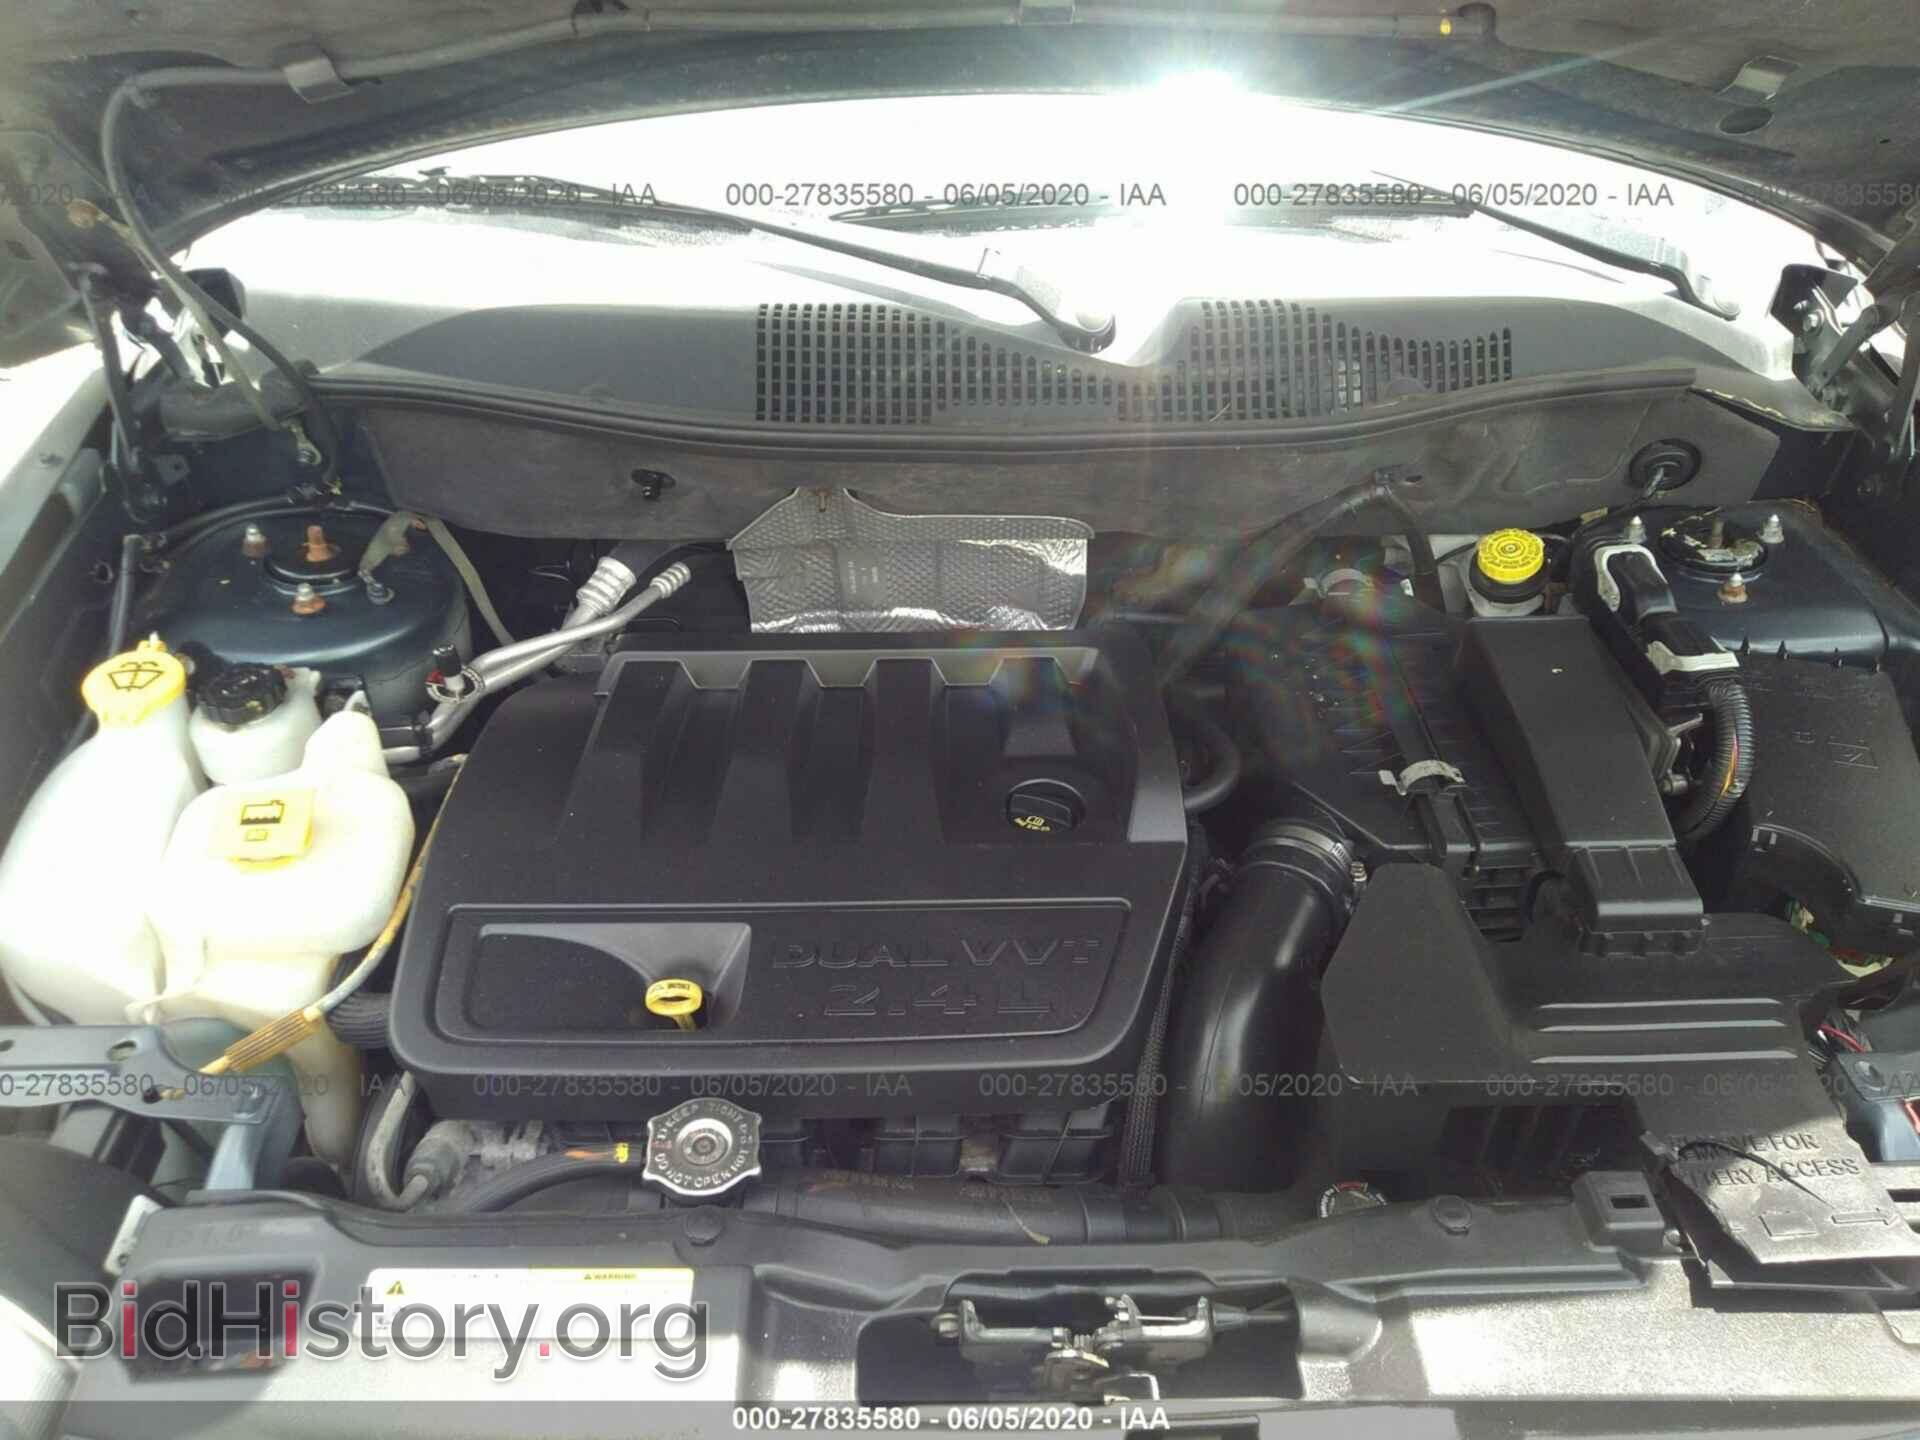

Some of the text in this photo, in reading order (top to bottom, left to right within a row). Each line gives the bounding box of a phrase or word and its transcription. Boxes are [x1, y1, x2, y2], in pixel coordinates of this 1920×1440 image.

[773, 937, 1100, 968] DUAL VVT
[824, 980, 1050, 1015] 2.4L
[1768, 1132, 1821, 1151] FOR
[1764, 1157, 1861, 1184] ACCESS
